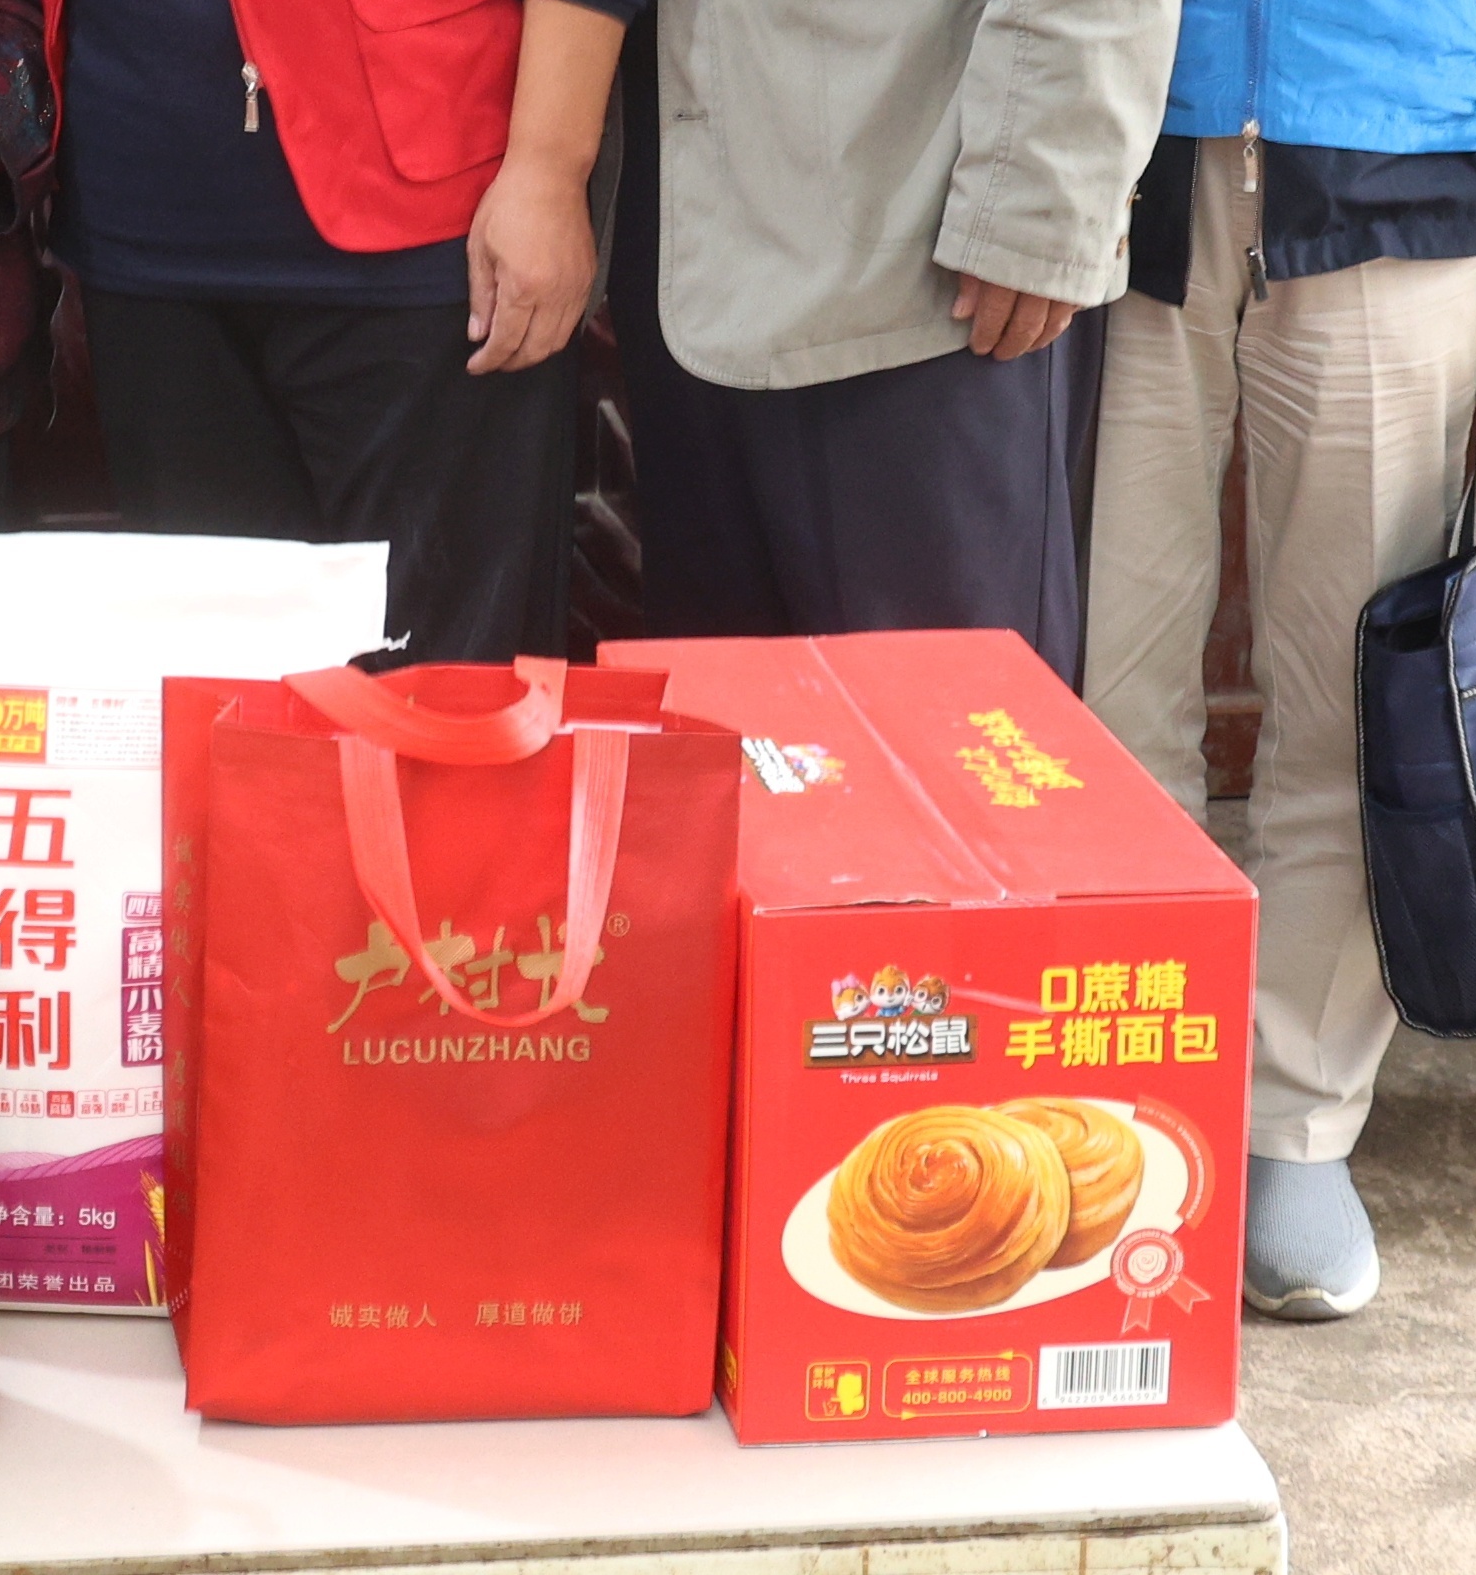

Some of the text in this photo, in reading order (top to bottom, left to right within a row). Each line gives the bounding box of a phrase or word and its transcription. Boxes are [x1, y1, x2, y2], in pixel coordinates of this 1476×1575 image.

[126, 927, 163, 1064] 高精小麦粉
[341, 1036, 592, 1066] LUCUNZHANG
[808, 1019, 972, 1059] 三只松鼠
[1004, 1013, 1220, 1071] 手撕面包
[840, 1072, 877, 1085] Three
[78, 1207, 116, 1230] 5kg
[329, 1300, 584, 1330] 诚实做人 厚道做饼
[904, 1367, 1012, 1386] 全球服务热线
[901, 1387, 1013, 1406] 400-800-4900
